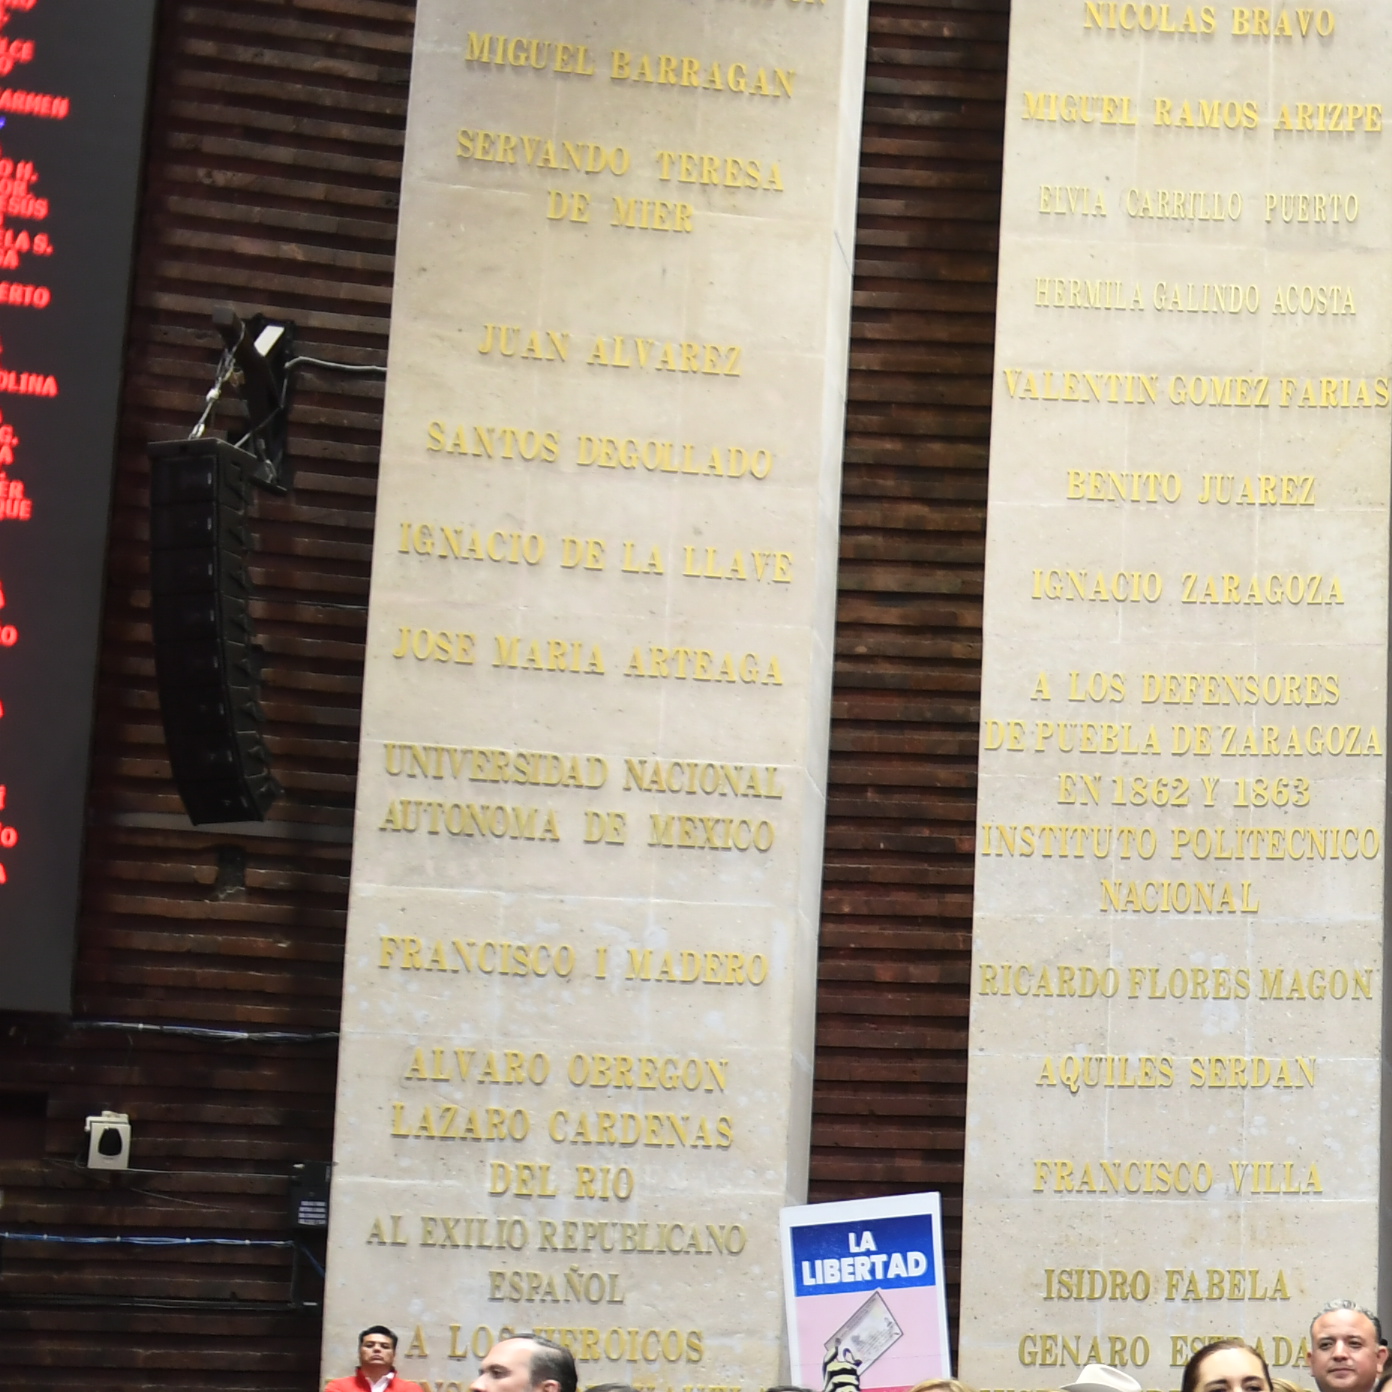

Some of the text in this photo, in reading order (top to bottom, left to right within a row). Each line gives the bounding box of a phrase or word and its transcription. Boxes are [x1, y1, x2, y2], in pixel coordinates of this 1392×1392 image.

[1086, 1, 1335, 37] NICOLAS BRAVO
[466, 32, 795, 96] MIGUEL BARRAGAN
[0, 88, 70, 119] ARMEN
[1024, 92, 1383, 132] MIGUEL RAMOS ARIZPE
[457, 130, 783, 190] SERVANDO TERESA
[548, 189, 693, 232] DE MIER
[1040, 184, 1360, 222] ELVIA CARRILLO PUERTO
[1036, 277, 1356, 314] HERMILA GALINDO ACOSTA
[478, 323, 741, 375] JUAN ALVAREZ
[1005, 369, 1390, 407] VALENTIN GOMEZ FARIAS
[427, 421, 773, 478] SANTOS DEGOLLADO
[1069, 469, 1316, 505] BENITO JUAREZ
[400, 521, 793, 582] IGNACIO DE LA LLAVE
[1033, 569, 1343, 604] IGNACIO ZARAGOZA
[393, 626, 783, 684] JOSE MARIA ARTEAGA
[1032, 671, 1340, 704] A LOS DEFENSORES
[986, 719, 1382, 755] DE PUEBLA DE ZARAGOZA
[386, 742, 783, 797] UNIVERSIDAD NACIONAL
[1060, 773, 1310, 806] EN 1862 Y 1863
[380, 798, 775, 850] AUTONOMA DE MEXICO
[982, 823, 1380, 859] INSTITUTO POLITECNICO
[1101, 879, 1260, 912] NACIONAL
[380, 936, 768, 984] FRANCISCO I MADERO
[980, 963, 1372, 998] RICARDO FLORES MAGON
[408, 1048, 728, 1090] ALVARO OBREGON
[1038, 1056, 1315, 1092] AQUILES SERDAN
[393, 1102, 734, 1147] LAZARO CARDENAS
[491, 1161, 634, 1198] DEL RIO
[1035, 1160, 1322, 1192] FRANCISCO VILLA
[370, 1213, 748, 1252] AL EXILIO REPUBLICANO
[849, 1231, 876, 1252] LA
[491, 1264, 624, 1302] ESPAÑOL
[802, 1252, 926, 1285] LIBERTAD
[1046, 1268, 1290, 1300] ISIDRO FABELA
[406, 1325, 427, 1356] A
[1019, 1333, 1150, 1365] GENARO
